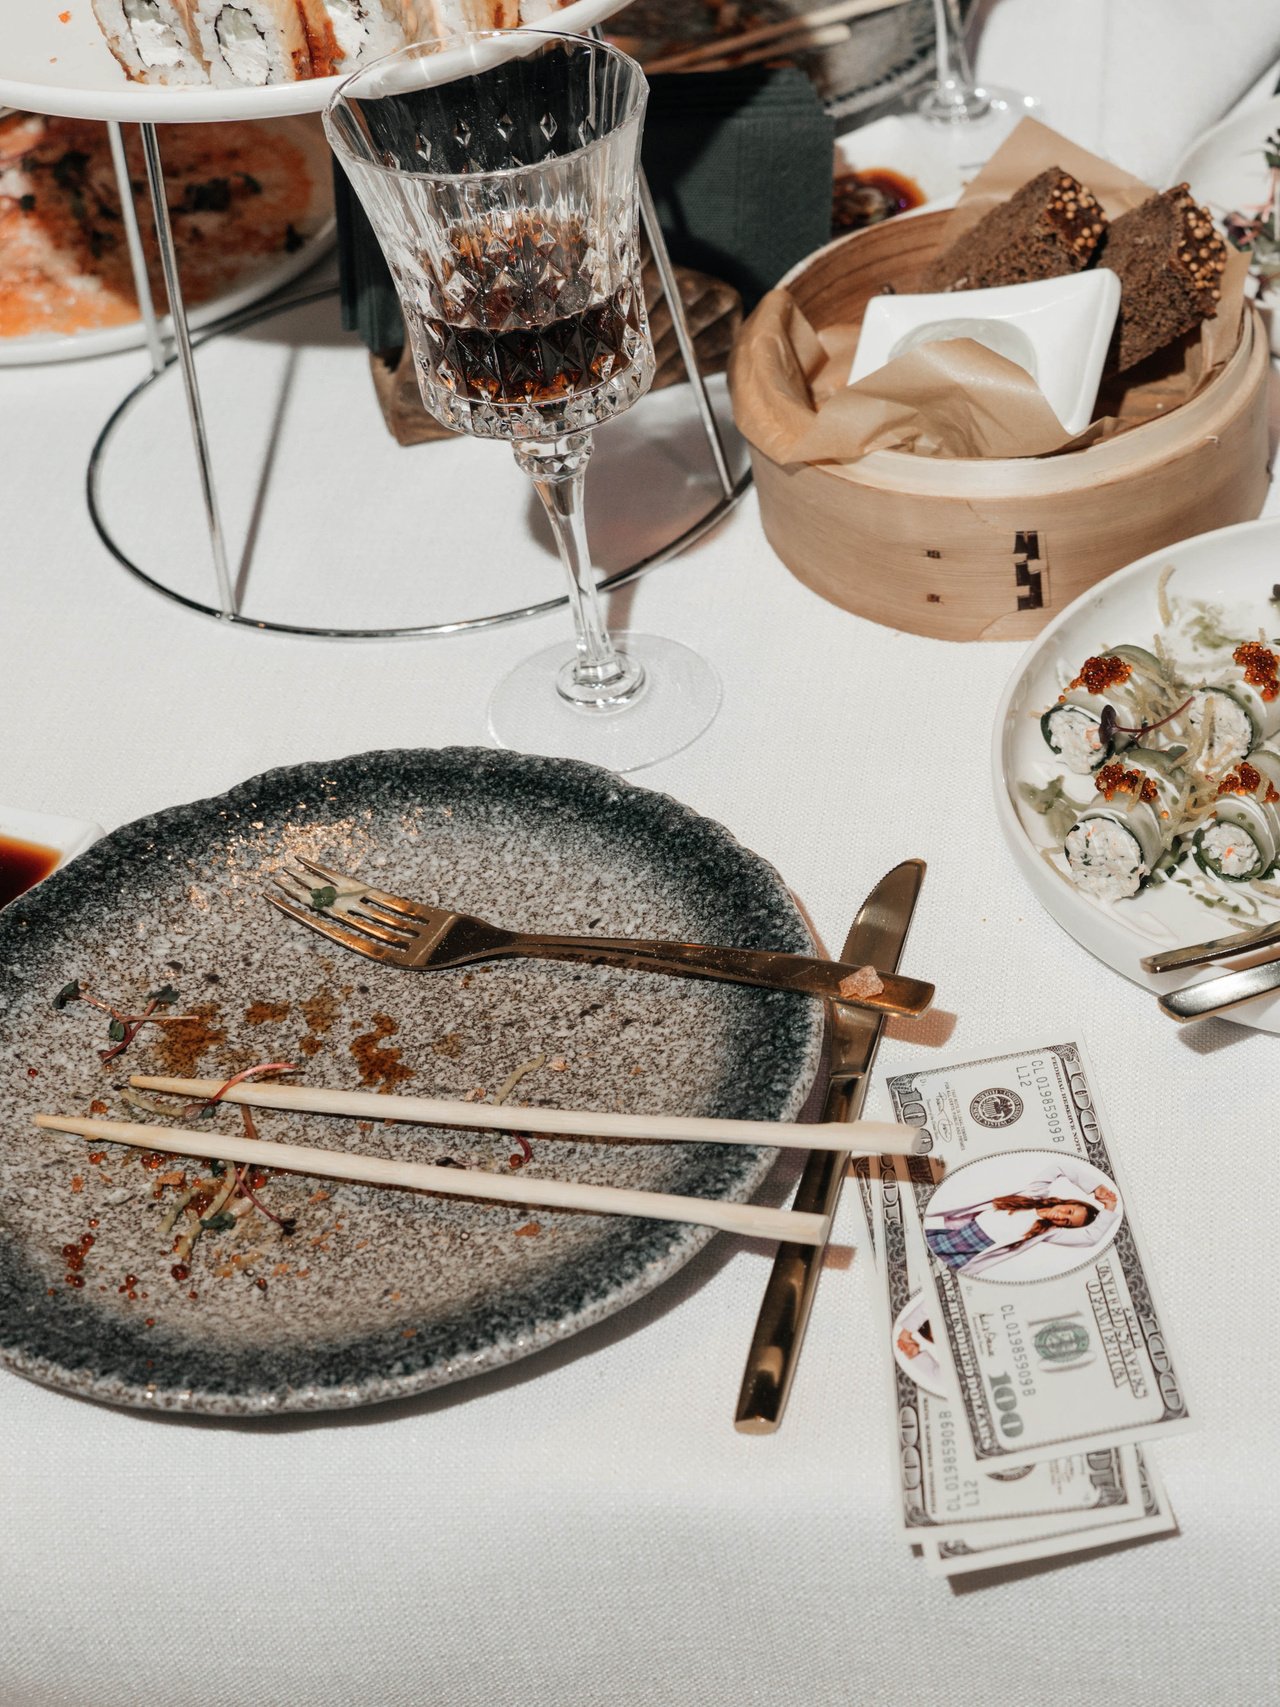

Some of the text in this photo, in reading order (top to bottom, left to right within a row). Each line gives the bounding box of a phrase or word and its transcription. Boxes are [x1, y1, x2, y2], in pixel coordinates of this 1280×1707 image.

[1014, 1064, 1033, 1088] L12
[1049, 1055, 1083, 1153] FEDERAL RESERVE NOTE
[1062, 1056, 1102, 1144] 100
[946, 1300, 975, 1377] HUNDRED
[964, 1375, 994, 1451] DOLLARS
[989, 1371, 1024, 1439] 100
[1138, 1312, 1183, 1411] 100
